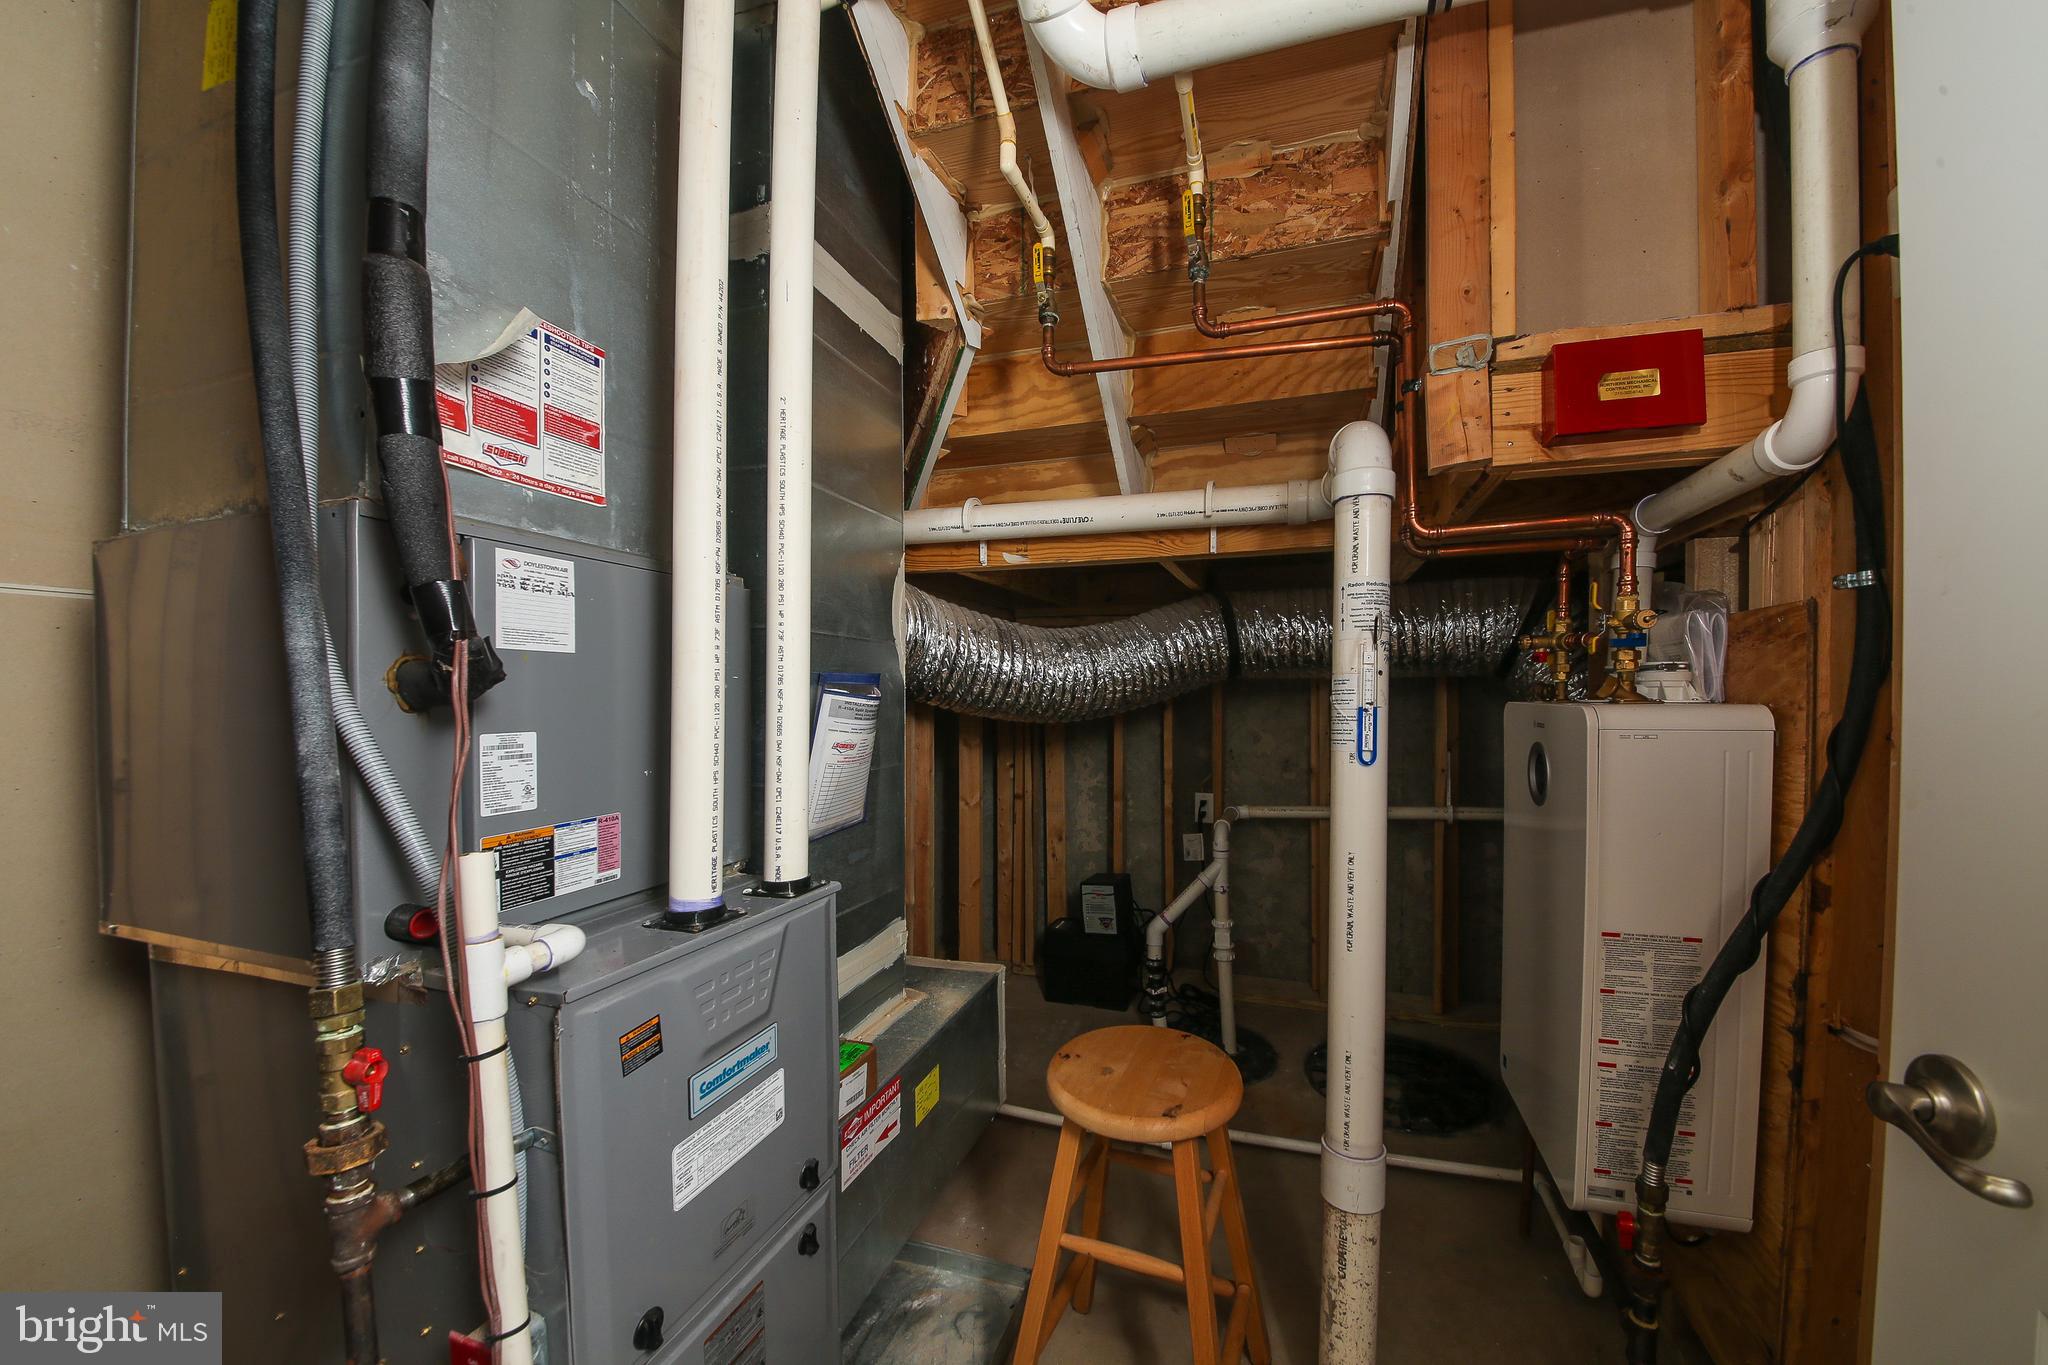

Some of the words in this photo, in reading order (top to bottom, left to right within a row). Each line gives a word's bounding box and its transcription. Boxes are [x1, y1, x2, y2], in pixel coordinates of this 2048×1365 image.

[542, 322, 580, 345] ESHOOTING
[485, 444, 528, 465] SOBIESKI
[520, 476, 538, 486] hours
[561, 488, 575, 496] days
[523, 560, 560, 571] DOYLESTOWN
[598, 816, 620, 824] R-410A
[699, 1041, 770, 1094] Comfortmaker
[864, 1080, 900, 1122] IMPORTANT
[846, 1137, 860, 1153] CHECK
[868, 1117, 881, 1132] FILTER
[848, 1144, 869, 1168] FILTER
